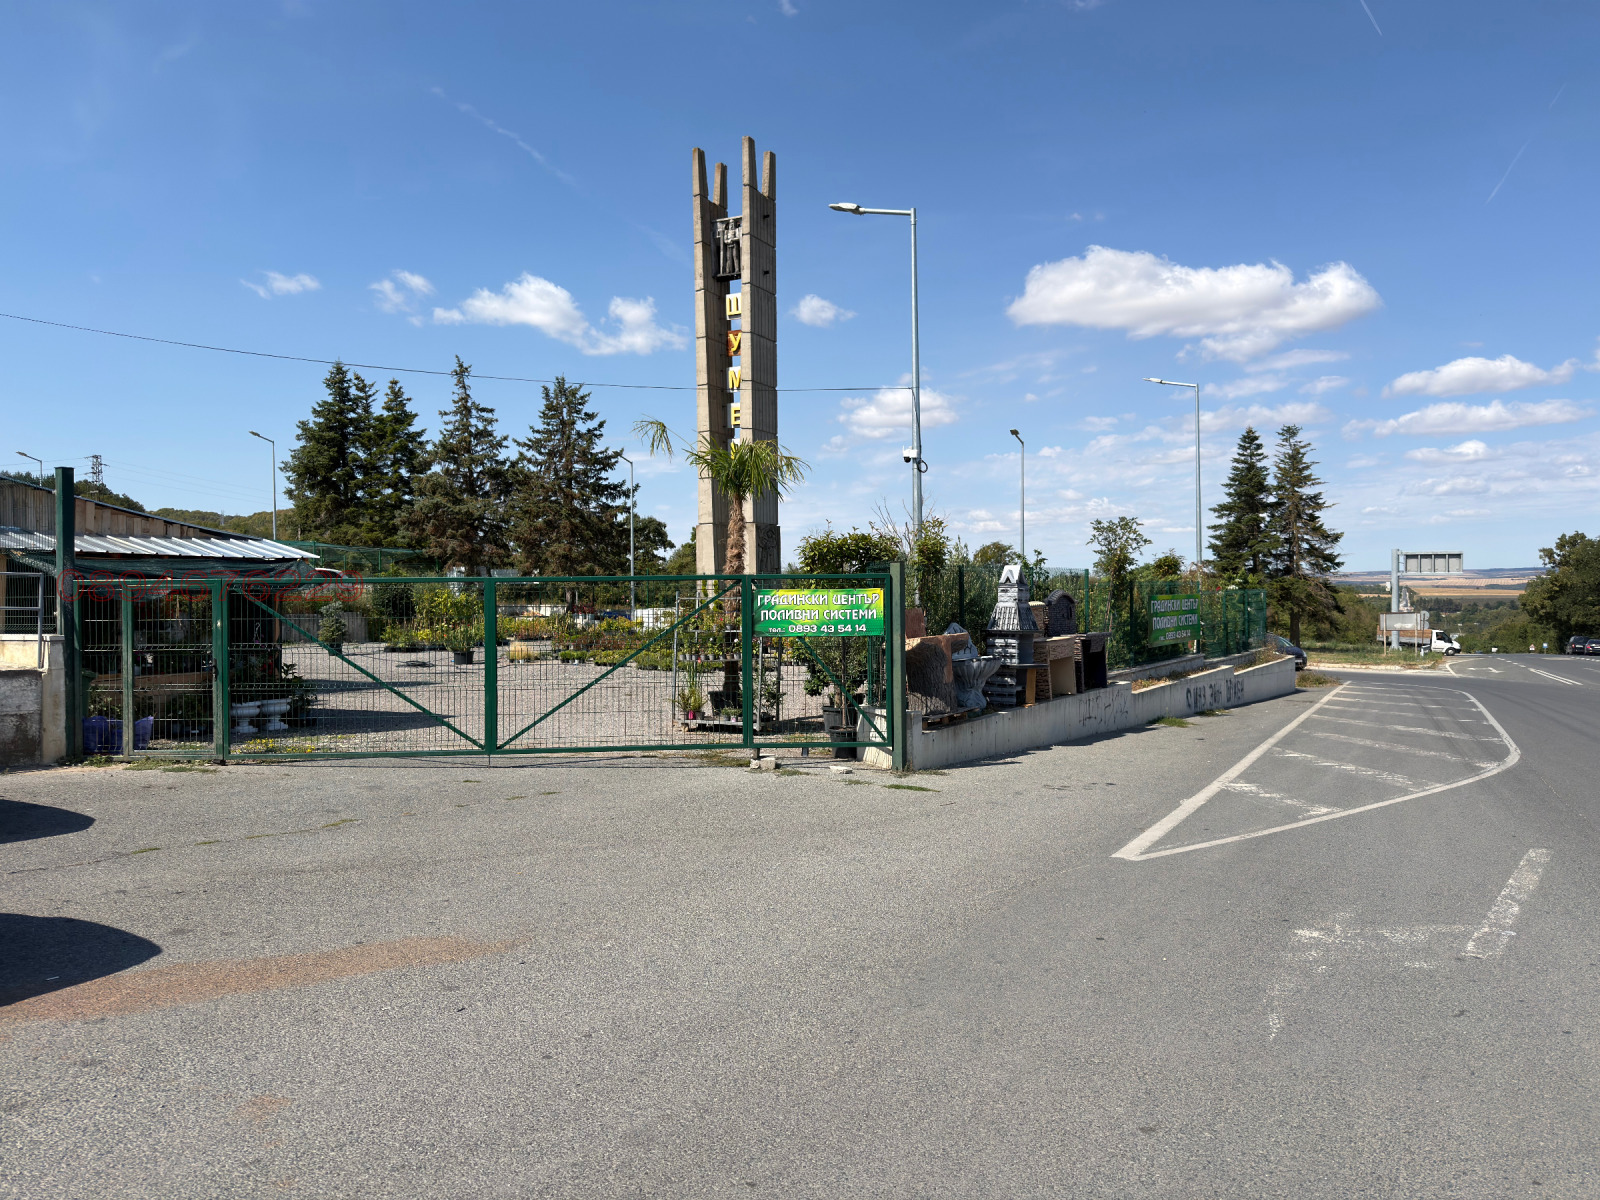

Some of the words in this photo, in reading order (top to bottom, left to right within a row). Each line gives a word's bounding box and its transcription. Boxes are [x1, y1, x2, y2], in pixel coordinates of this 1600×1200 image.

[757, 594, 829, 606] ГРАДИНСКИ
[832, 593, 880, 605] ЦЕНТЪР
[760, 609, 819, 621] ПОЛИВНИ
[823, 608, 877, 620] СИСТЕМИ
[788, 624, 817, 633] 0893
[820, 624, 835, 633] 43
[837, 624, 852, 633] 54
[854, 624, 867, 632] 14
